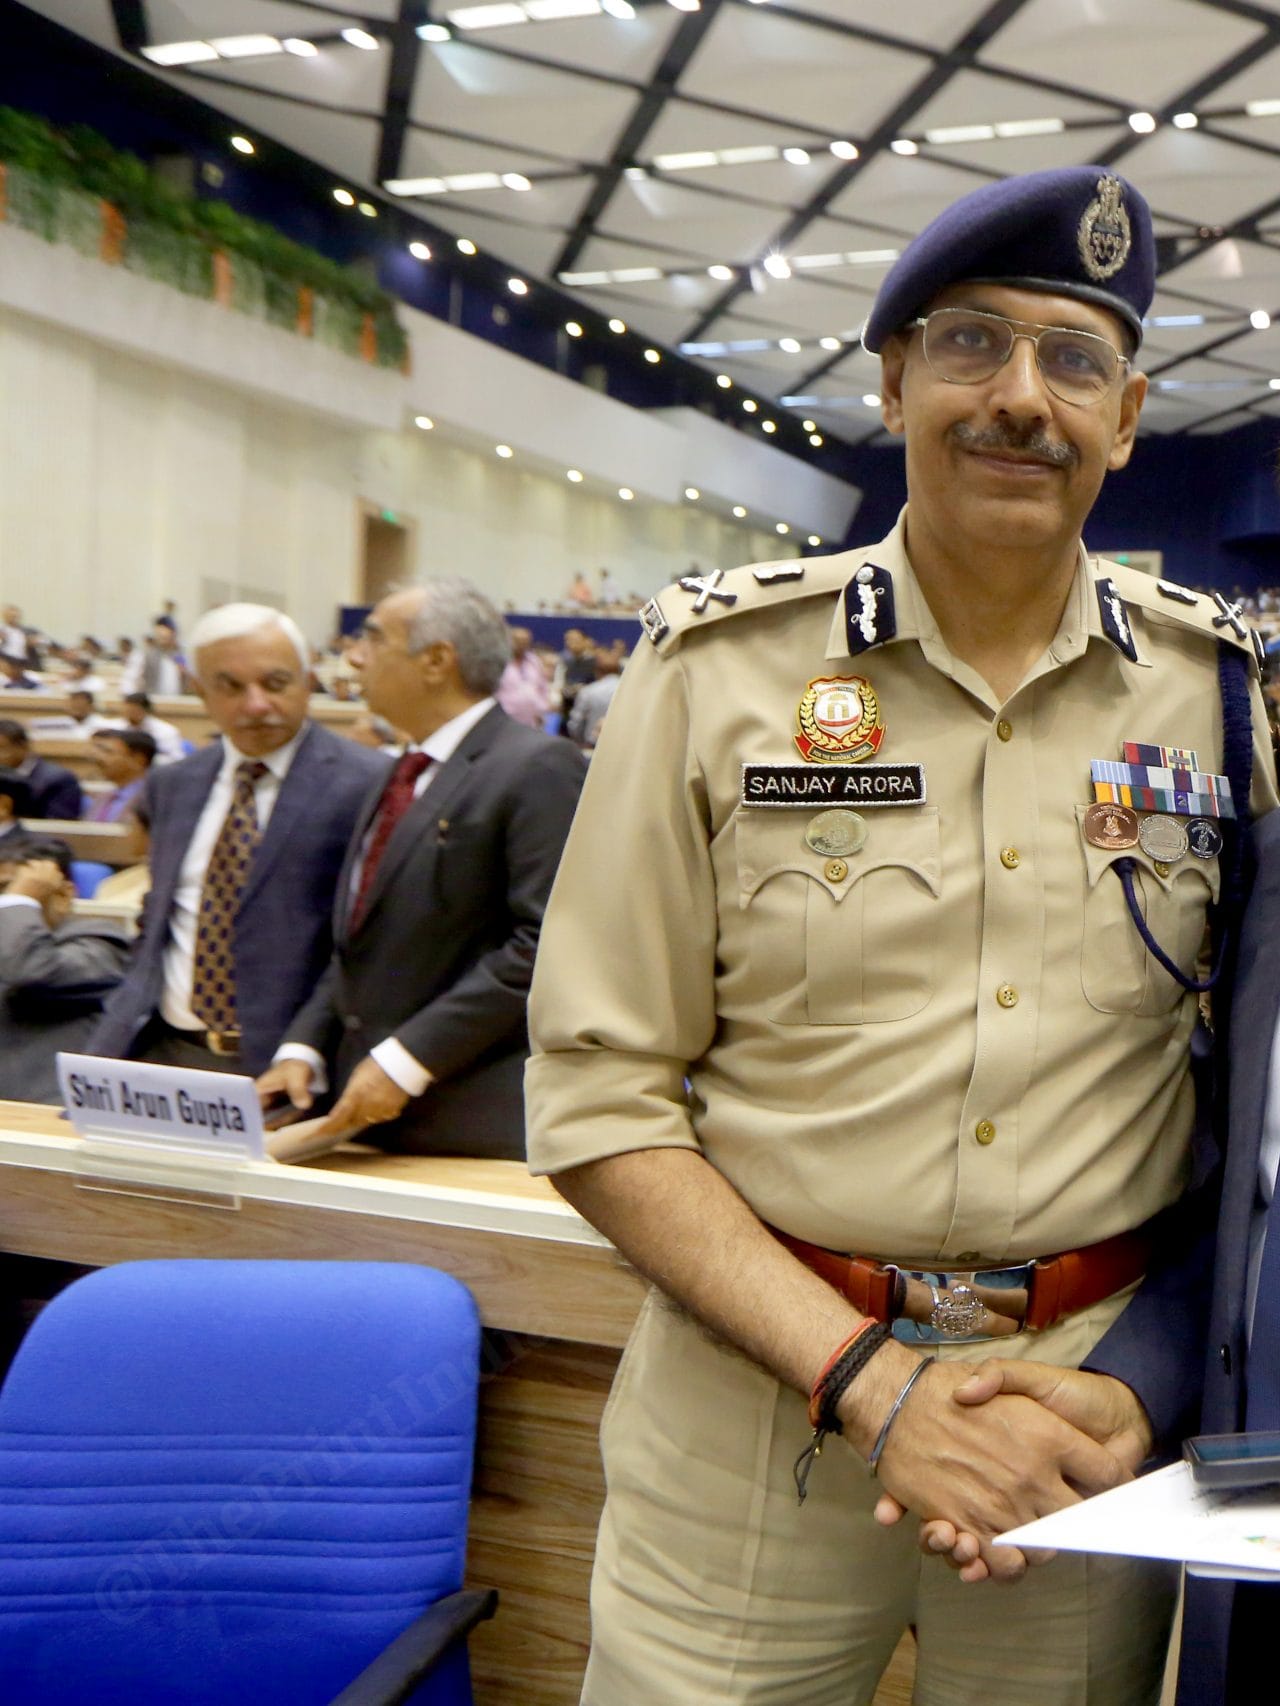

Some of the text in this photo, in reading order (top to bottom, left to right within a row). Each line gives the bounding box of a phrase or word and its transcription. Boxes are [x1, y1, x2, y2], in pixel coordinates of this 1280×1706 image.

[749, 775, 916, 795] SANJAY ARORA
[69, 1073, 246, 1136] Shri Arun Gupta
